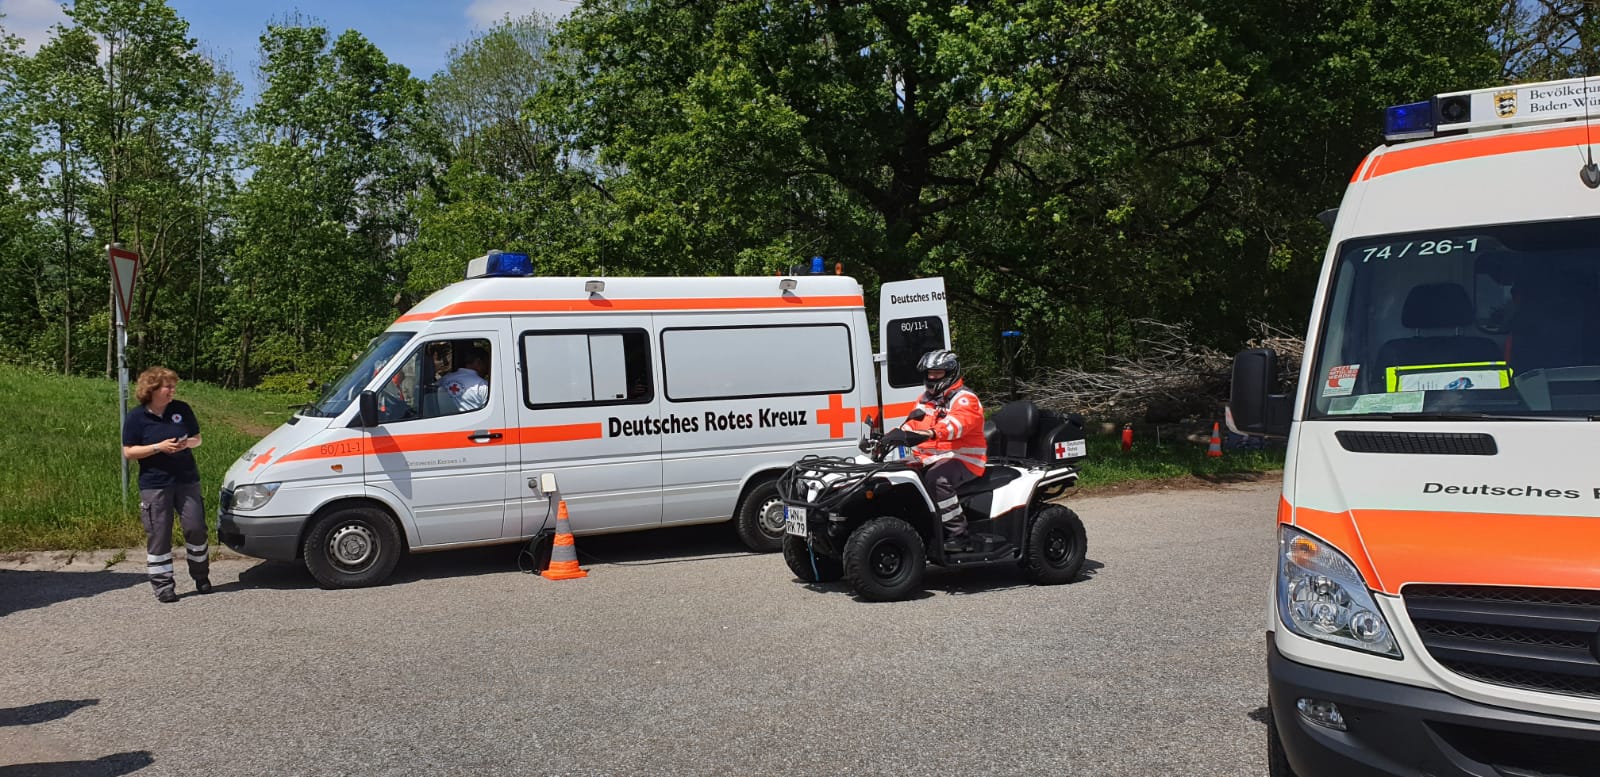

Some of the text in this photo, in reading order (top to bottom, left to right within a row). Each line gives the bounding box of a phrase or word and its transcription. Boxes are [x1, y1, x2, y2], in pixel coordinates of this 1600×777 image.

[1363, 246, 1392, 263] 74
[1418, 238, 1478, 256] 26-1
[890, 293, 930, 305] Deutsches
[901, 320, 929, 333] 60/11-1
[608, 407, 808, 438] Deutsches Rotes Kreuz
[320, 441, 361, 457] 60/11-1
[1422, 482, 1581, 499] Deutsches
[790, 510, 800, 521] WN
[797, 522, 806, 535] 79
